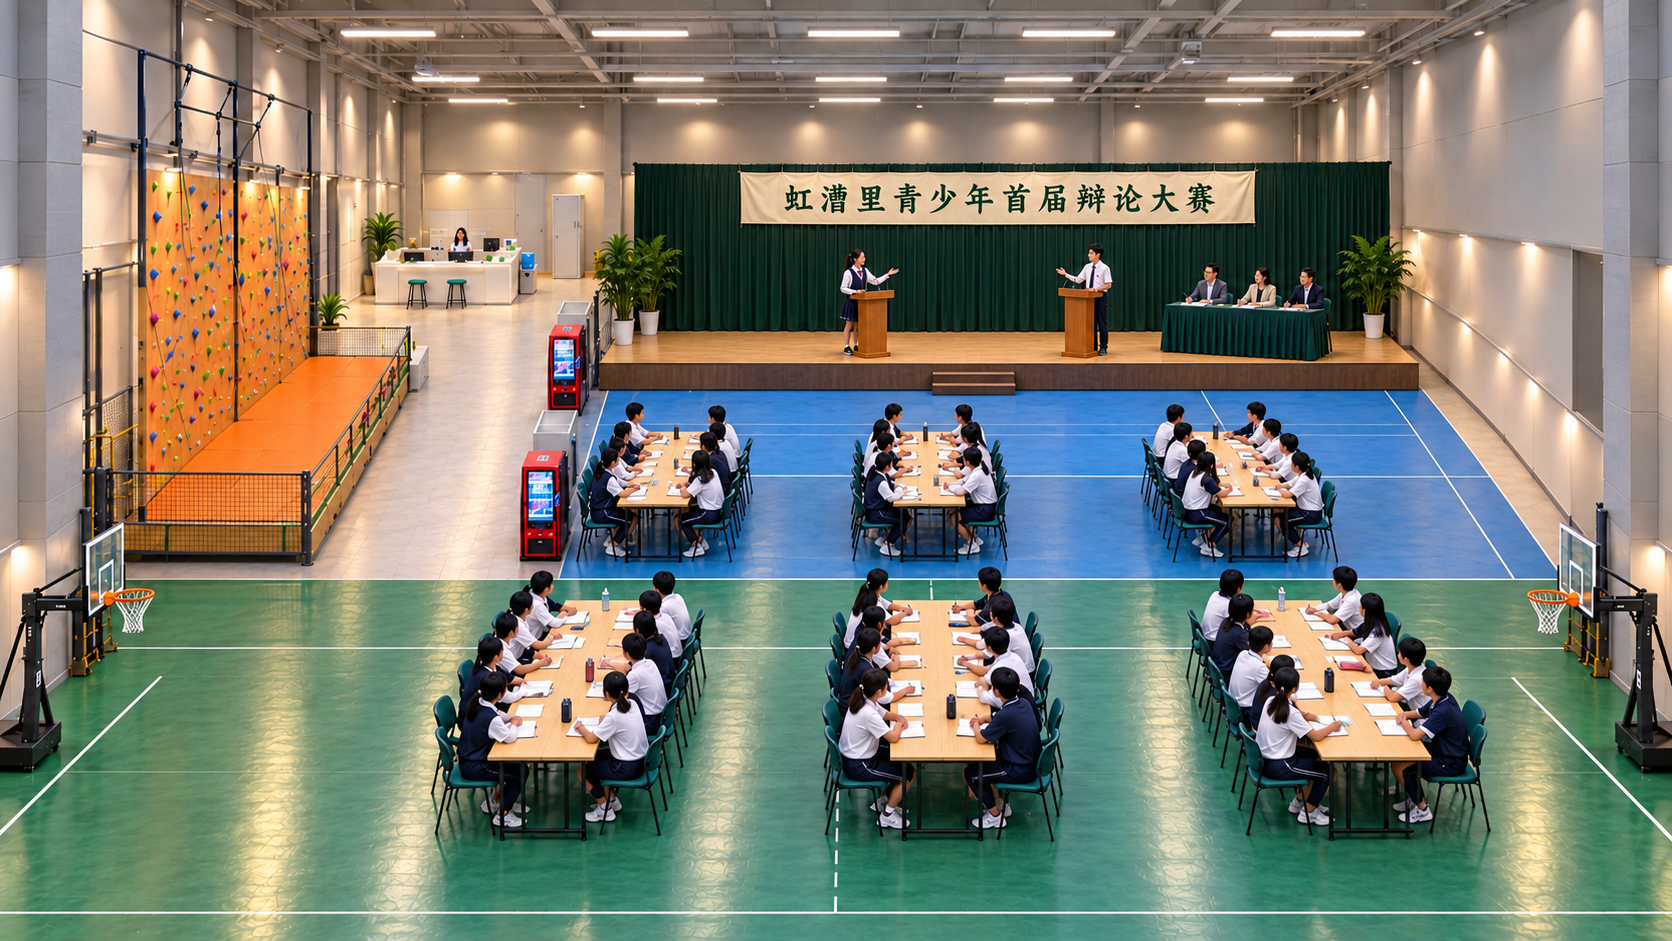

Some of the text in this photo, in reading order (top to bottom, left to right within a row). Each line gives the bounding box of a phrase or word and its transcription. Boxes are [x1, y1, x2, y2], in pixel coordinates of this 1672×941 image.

[784, 182, 1216, 215] 虹漕里青少年首届辩论大赛
